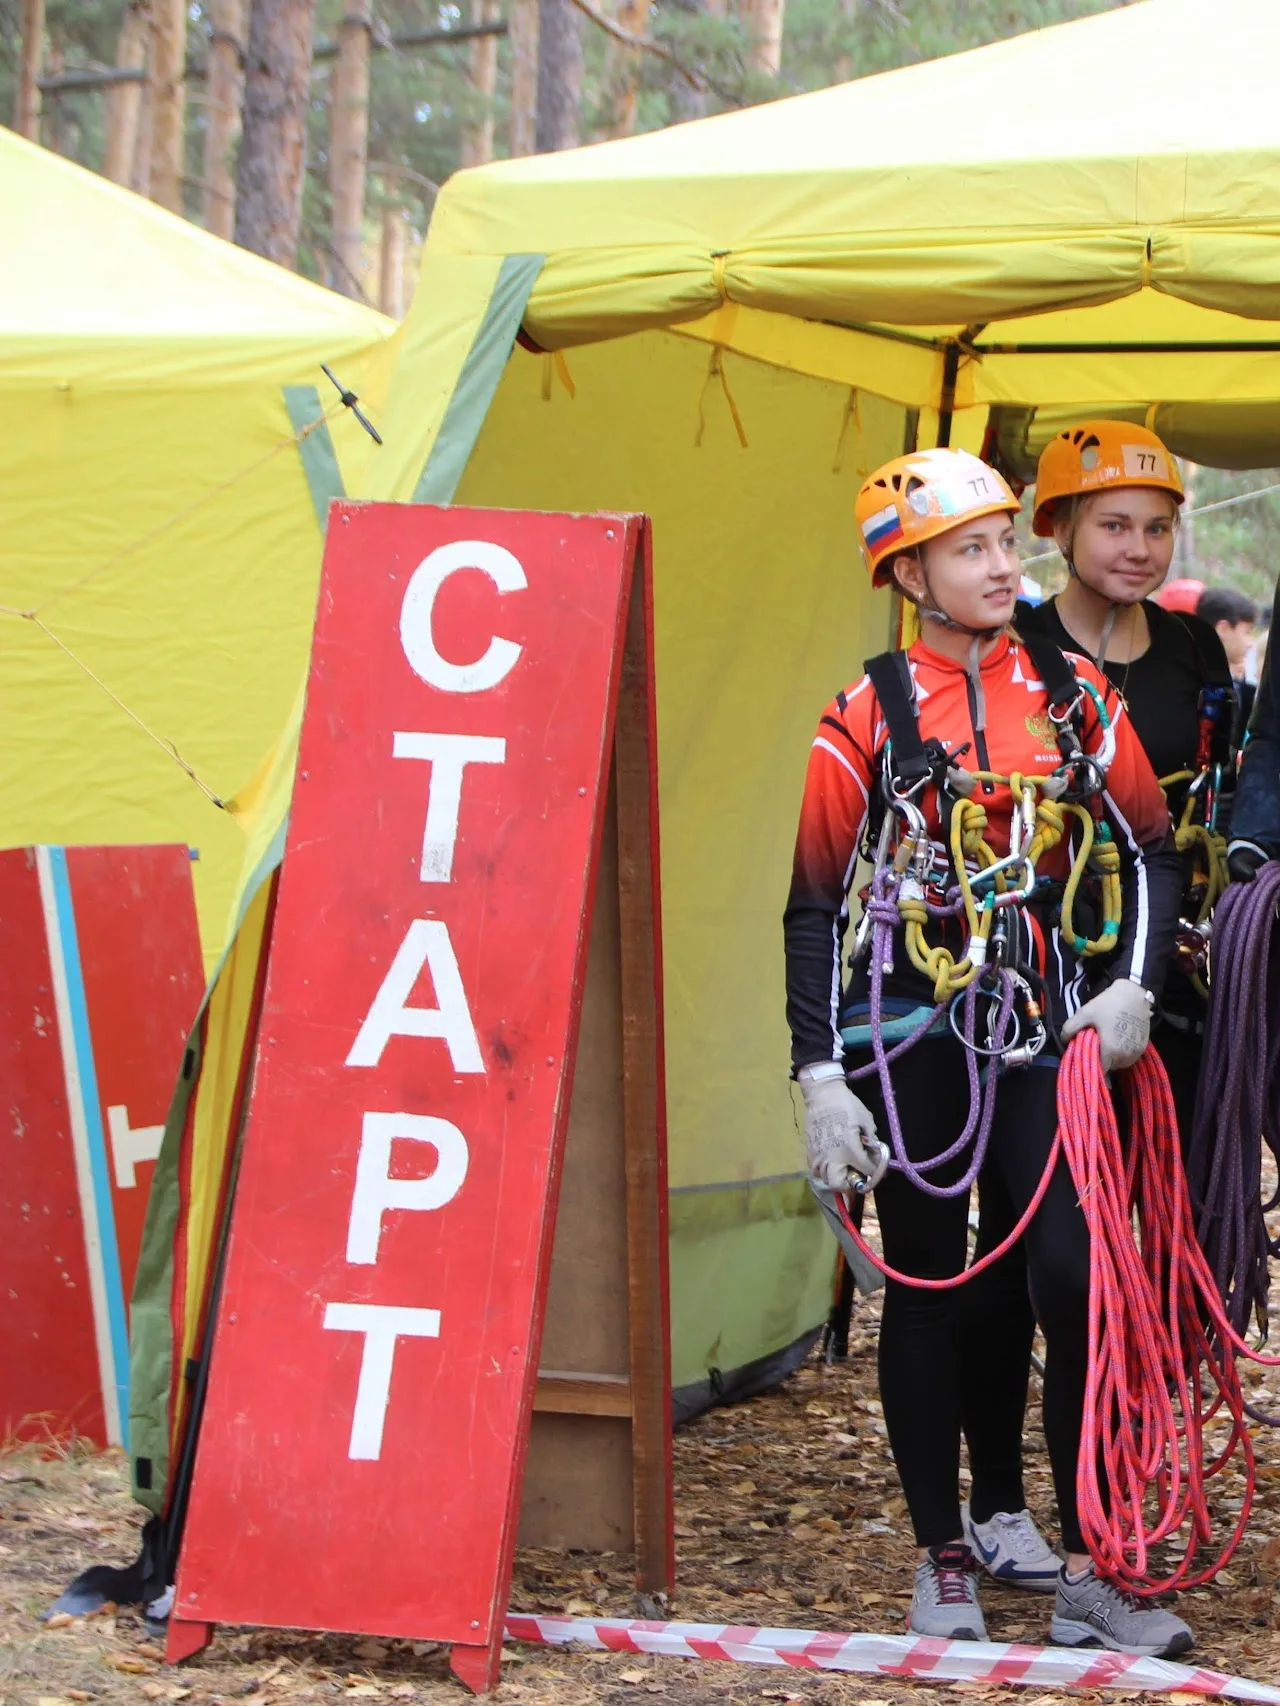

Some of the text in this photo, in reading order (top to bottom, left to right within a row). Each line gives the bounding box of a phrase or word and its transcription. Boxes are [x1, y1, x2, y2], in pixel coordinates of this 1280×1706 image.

[1137, 453, 1156, 471] 77
[967, 477, 989, 497] 77
[1034, 754, 1063, 762] RUSSI
[323, 540, 528, 1461] СТАРТ
